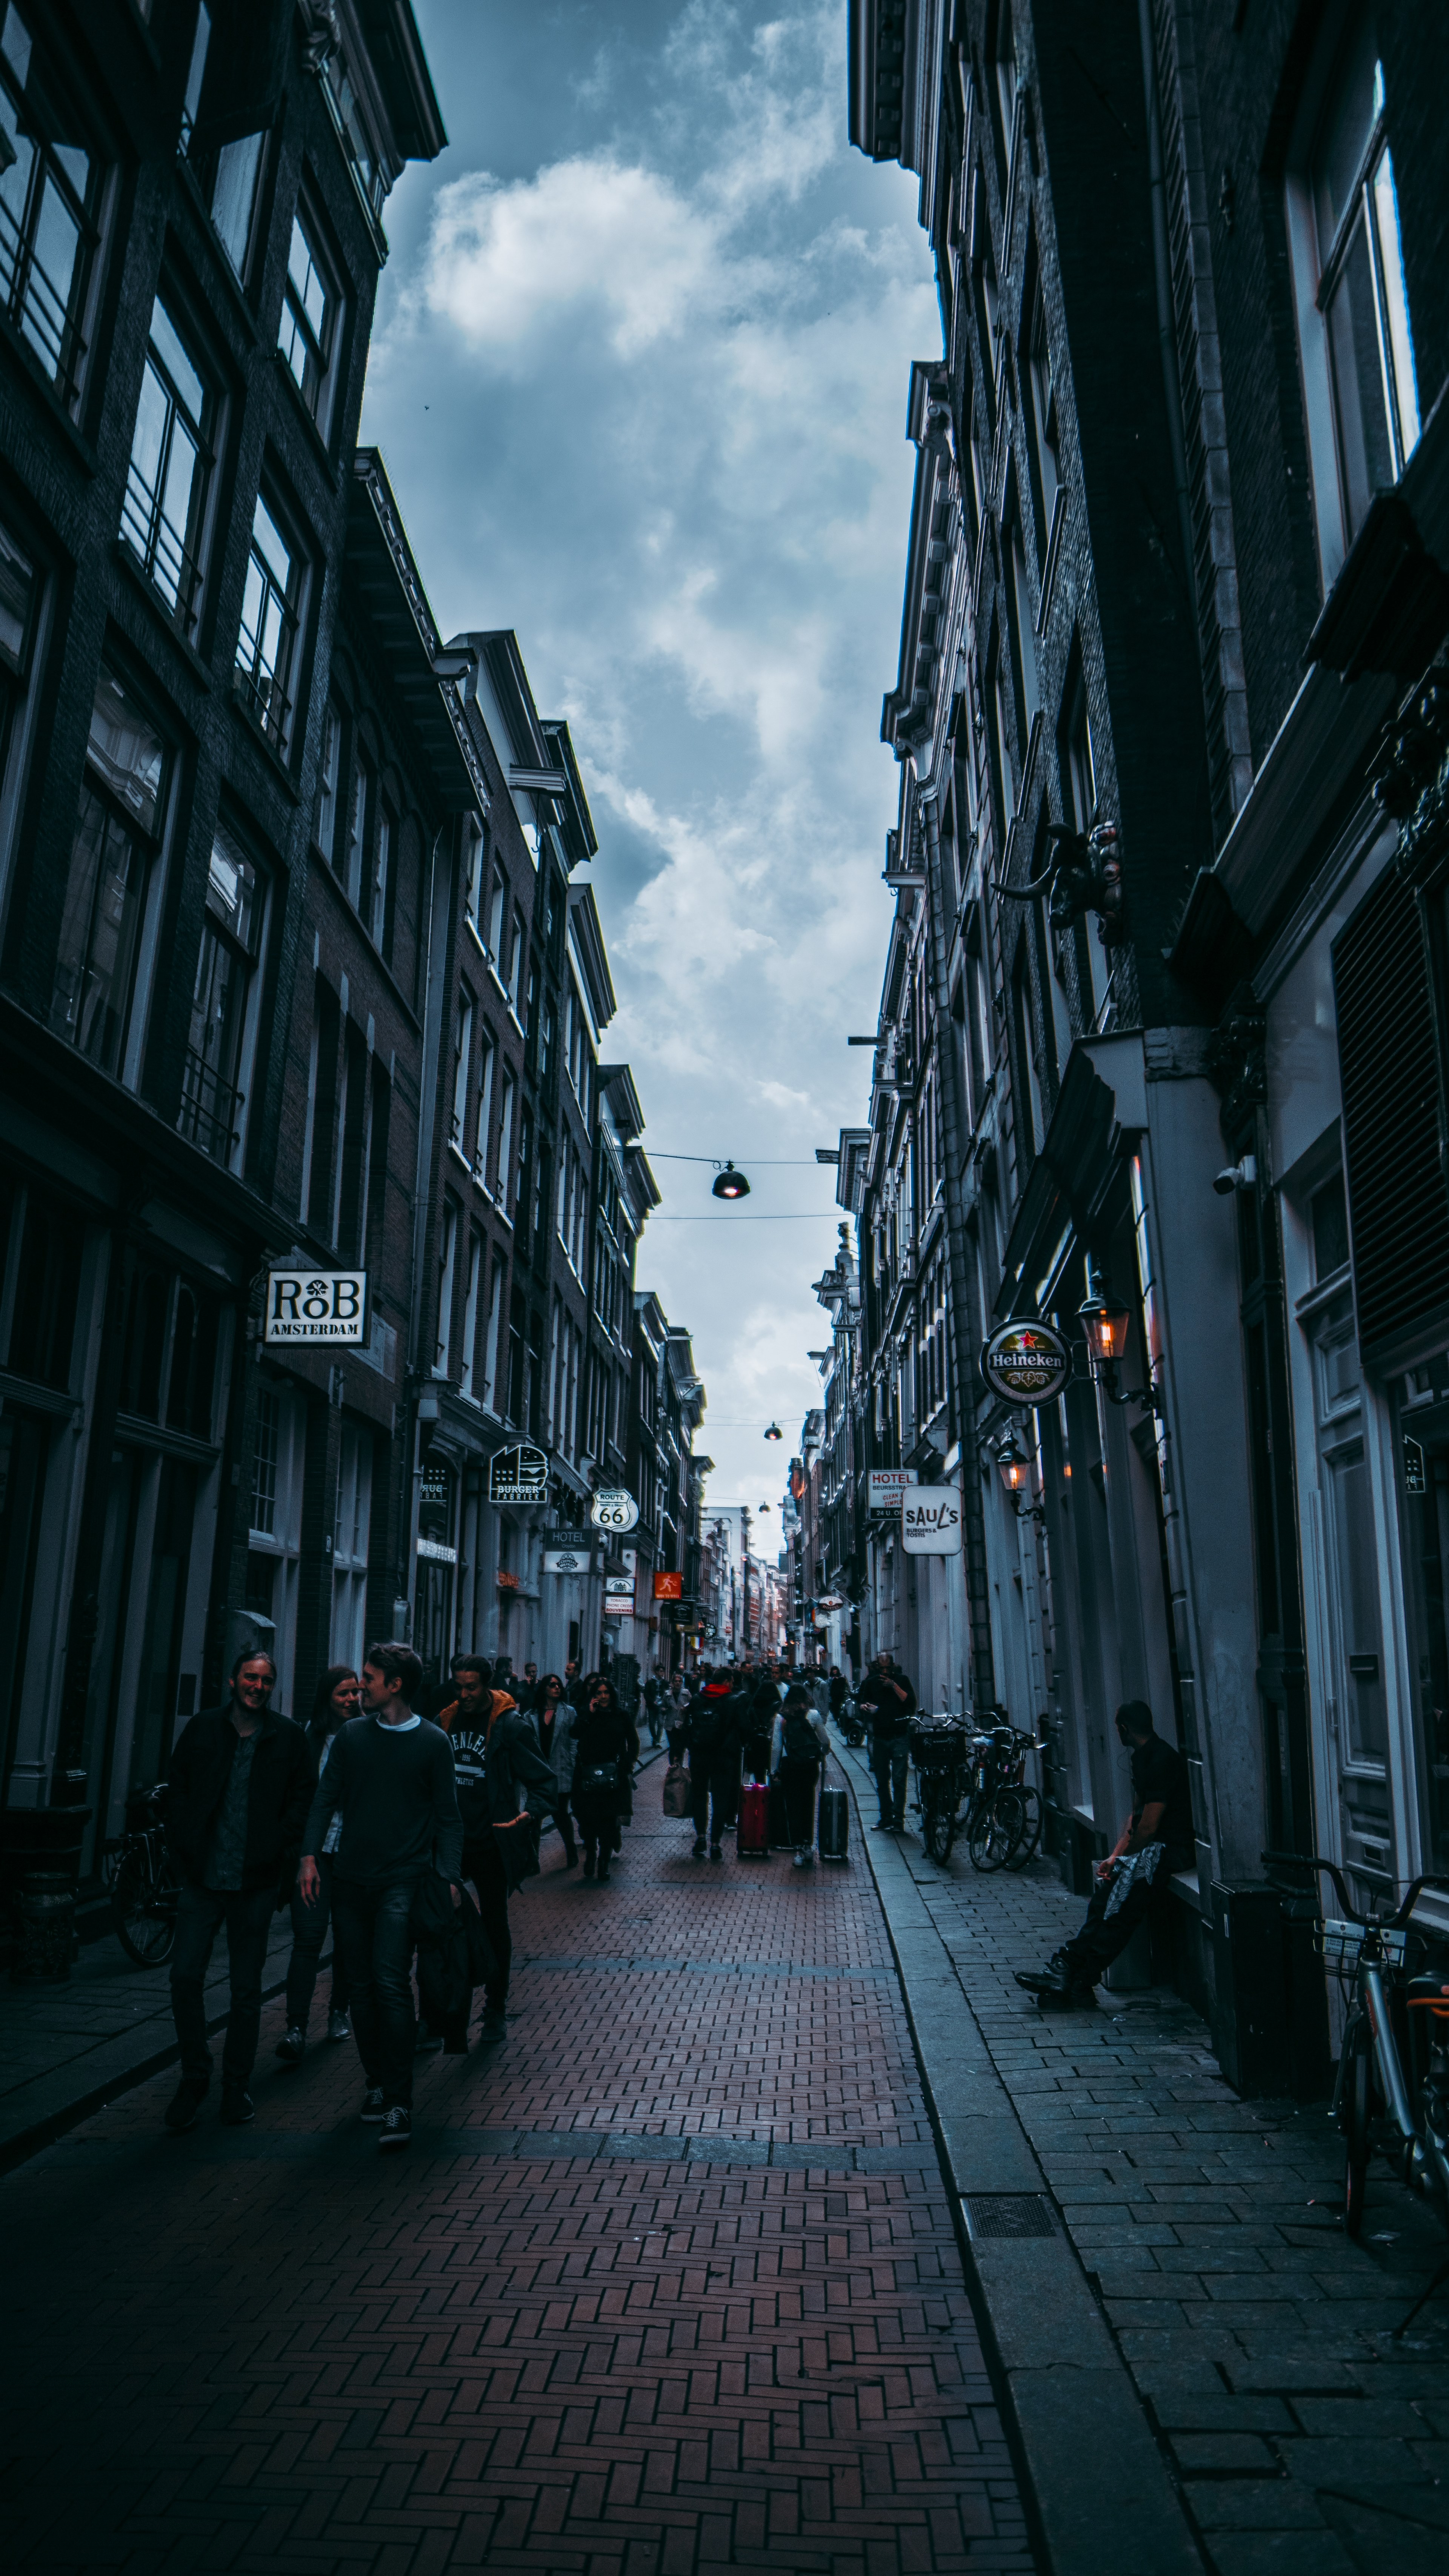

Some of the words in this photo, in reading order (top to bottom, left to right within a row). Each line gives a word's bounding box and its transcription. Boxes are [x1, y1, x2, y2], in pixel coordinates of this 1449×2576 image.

[271, 1324, 358, 1335] AMSTERDAM
[992, 1353, 1062, 1368] Heineken
[872, 1474, 914, 1483] HOTEL
[884, 1499, 902, 1507] SIMPLE
[600, 1508, 624, 1524] 66
[906, 1503, 958, 1529] SAUL'S
[553, 1532, 585, 1542] HOTEL
[455, 1777, 474, 1786] THLETICS
